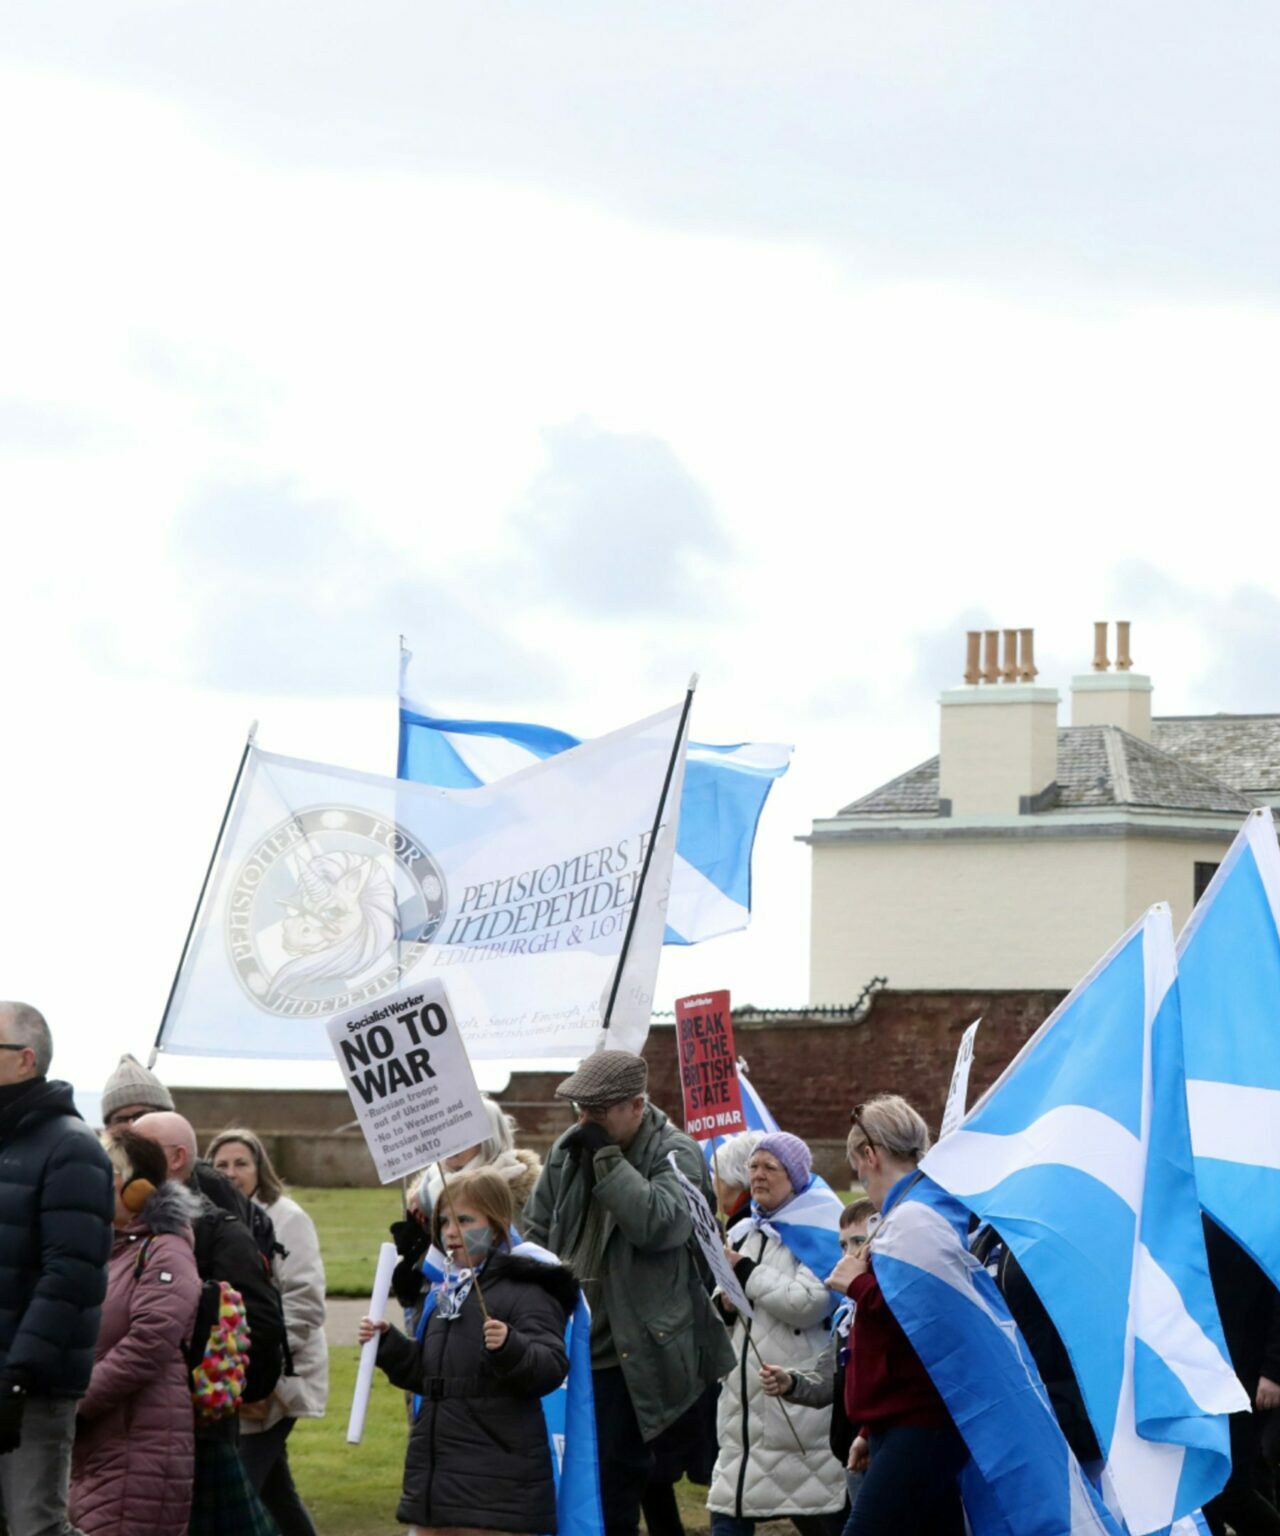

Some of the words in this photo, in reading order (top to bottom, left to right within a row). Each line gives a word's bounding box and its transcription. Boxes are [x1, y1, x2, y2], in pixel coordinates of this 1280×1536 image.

[367, 822, 421, 868] FOR
[458, 840, 628, 914] PENSIONERS
[566, 924, 583, 947] &
[589, 908, 631, 941] LOT
[339, 1025, 394, 1072] NO
[397, 1003, 448, 1046] TO
[680, 1012, 725, 1041] BREAK
[681, 1042, 695, 1064] UP
[700, 1035, 730, 1060] THE
[350, 1048, 437, 1105] WAR
[683, 1057, 734, 1088] BRITISH
[407, 1084, 438, 1102] troops
[690, 1082, 730, 1109] STATE
[374, 1118, 389, 1130] out
[391, 1110, 401, 1121] of
[403, 1097, 440, 1117] Ukraine
[393, 1124, 403, 1135] to
[404, 1111, 445, 1131] Western
[447, 1099, 464, 1114] and
[687, 1119, 700, 1134] NO
[703, 1117, 715, 1130] TO
[716, 1110, 741, 1127] WAR
[382, 1133, 419, 1154] Russian
[420, 1110, 473, 1138] imperialism
[402, 1148, 413, 1160] to
[414, 1138, 441, 1155] NATO
